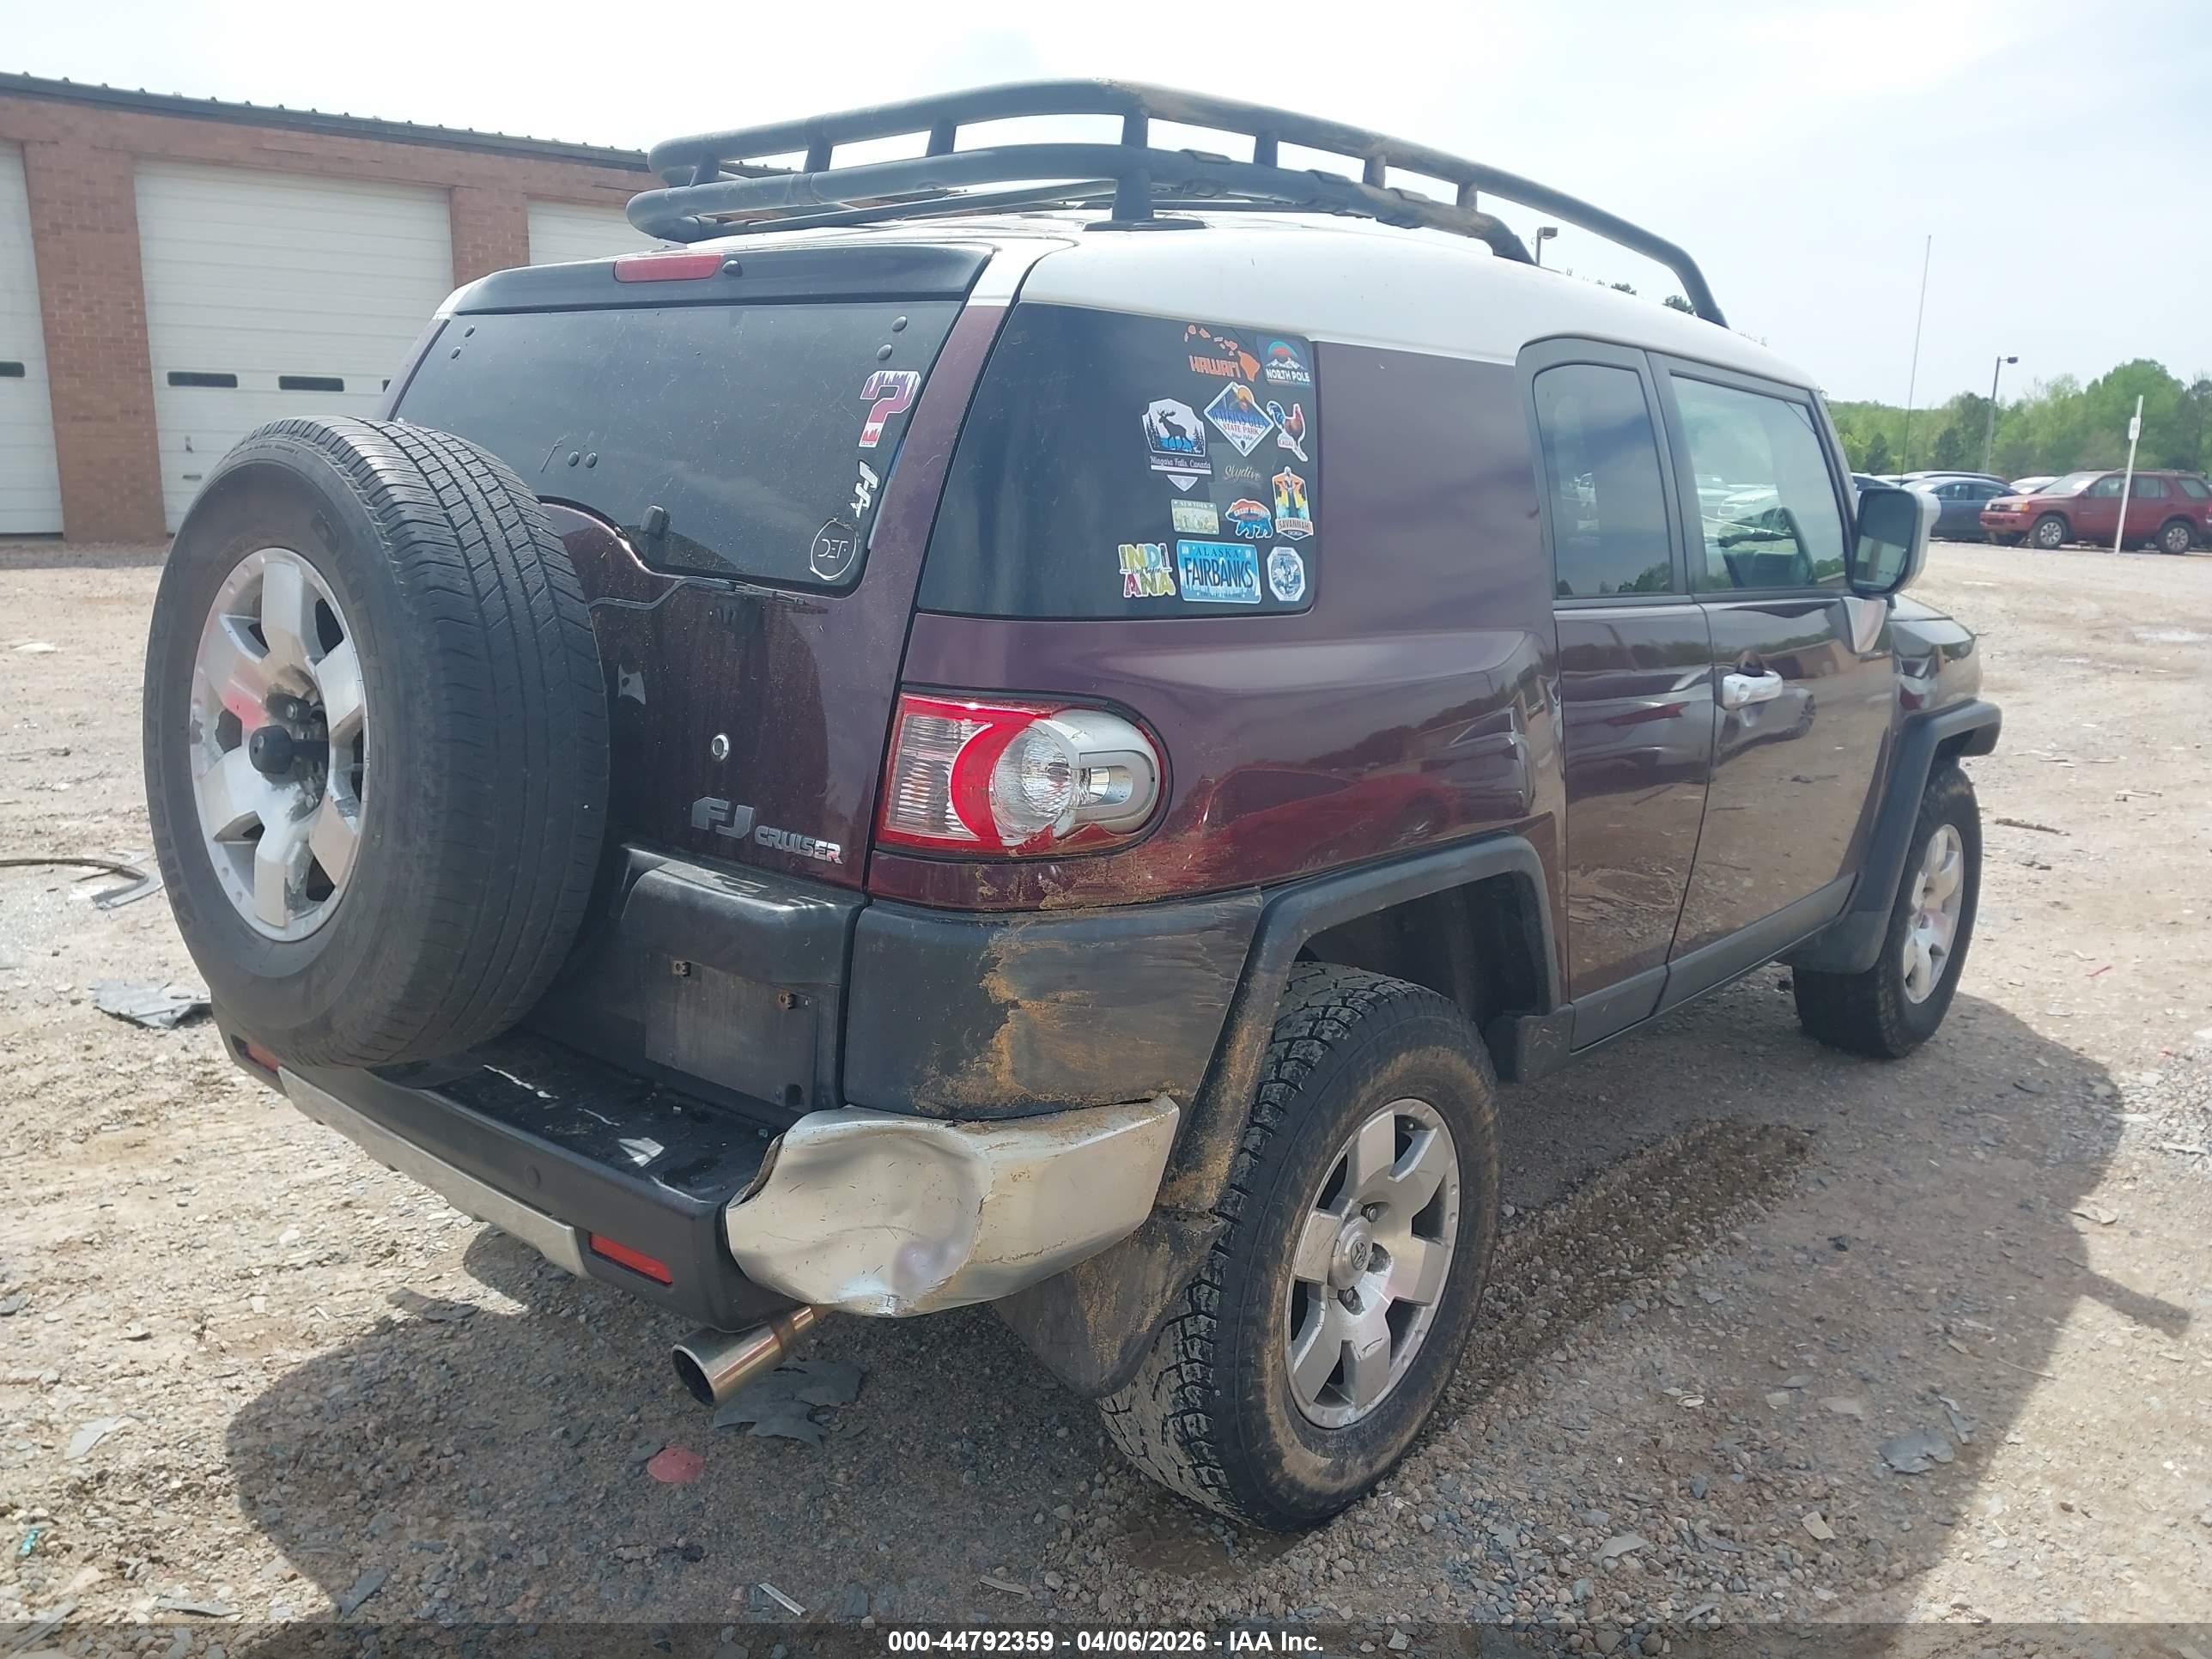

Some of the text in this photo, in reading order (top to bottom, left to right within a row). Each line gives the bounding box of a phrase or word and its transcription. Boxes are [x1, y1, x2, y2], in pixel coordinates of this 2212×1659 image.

[1267, 368, 1310, 382] NORTH POLE
[1223, 422, 1260, 435] STATE PARK
[1150, 456, 1173, 467] Niagara
[1189, 459, 1211, 469] Canada
[1278, 519, 1310, 531] SAVANNAH
[1196, 547, 1240, 558] ALASKA
[1184, 557, 1254, 588] FAIRBANKS
[690, 796, 845, 865] FJ CRUISER
